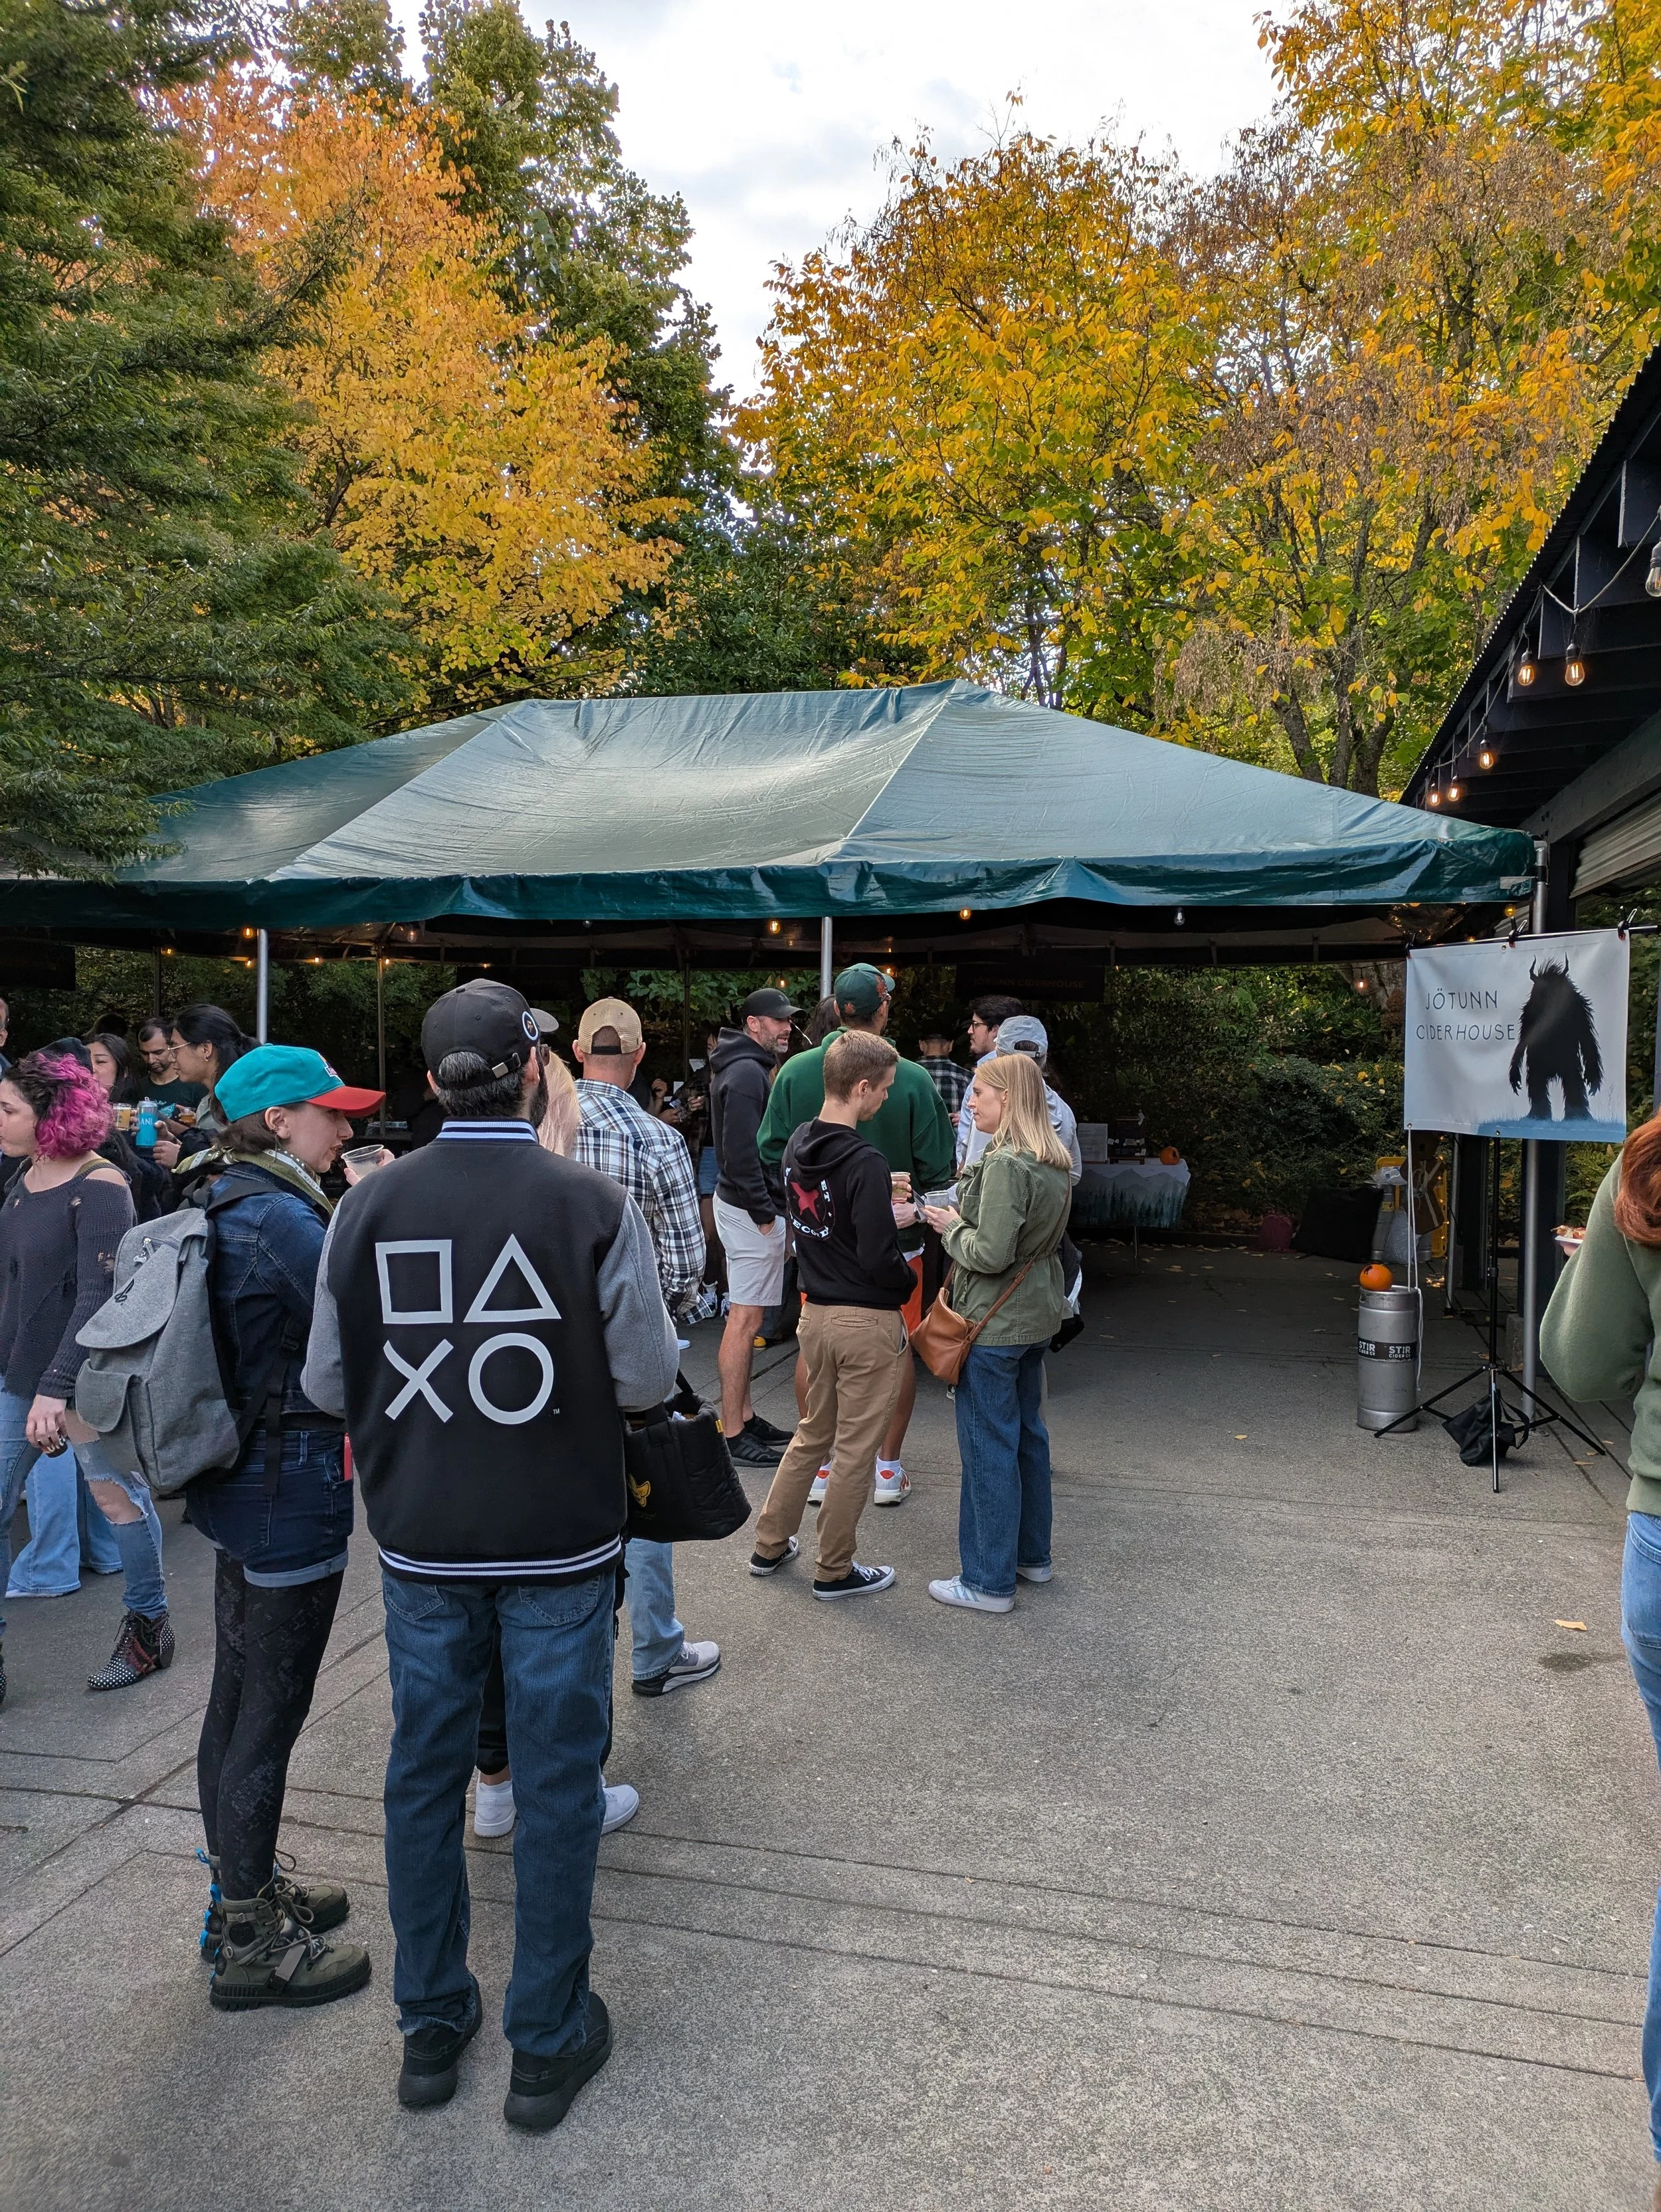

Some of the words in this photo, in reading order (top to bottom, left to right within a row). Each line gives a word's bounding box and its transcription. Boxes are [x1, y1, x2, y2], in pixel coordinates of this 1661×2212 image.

[1425, 987, 1498, 1010] JÖTUNN
[1359, 1340, 1375, 1352] STIR
[1389, 1346, 1411, 1354] STIR
